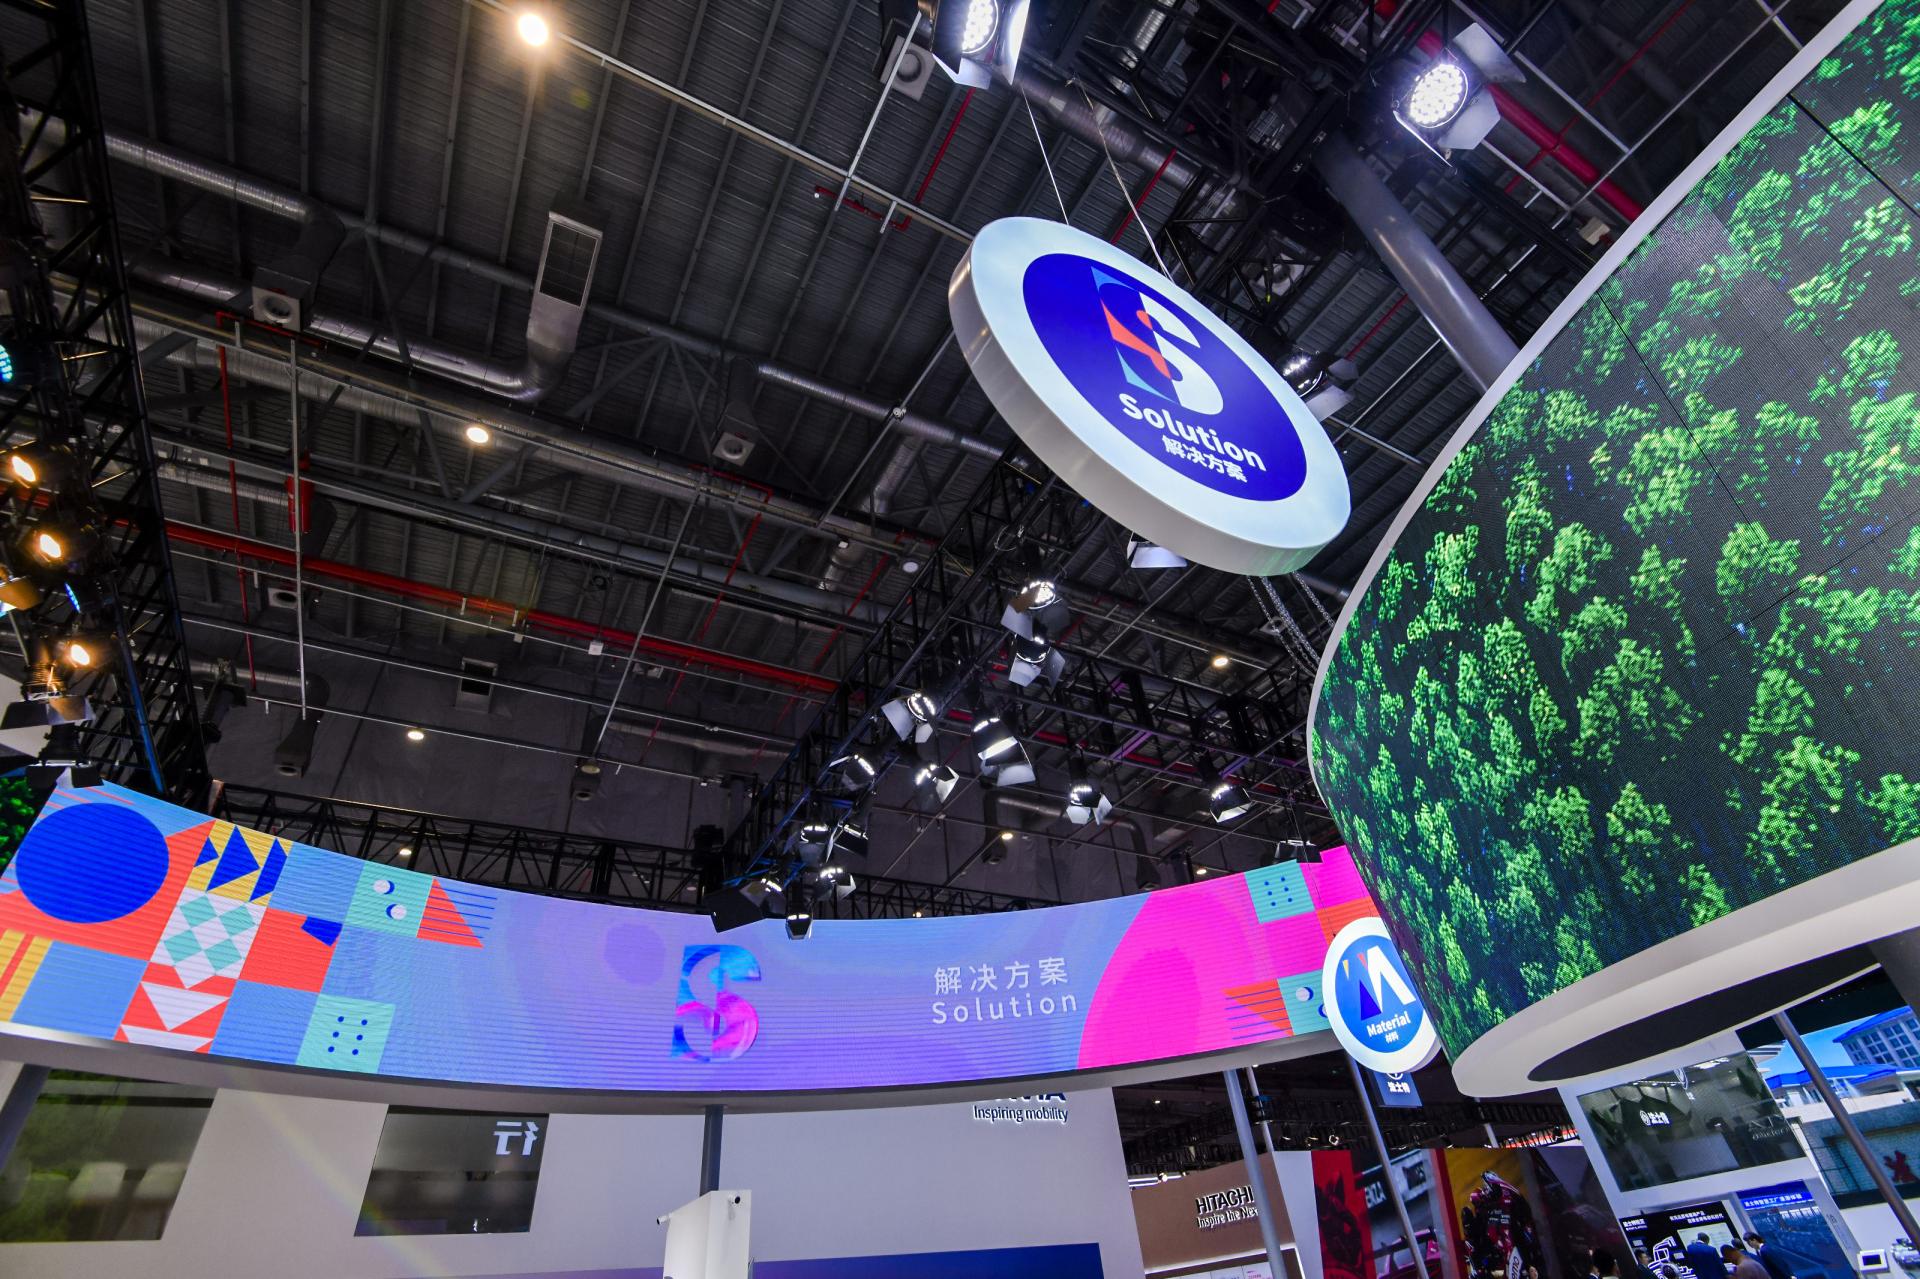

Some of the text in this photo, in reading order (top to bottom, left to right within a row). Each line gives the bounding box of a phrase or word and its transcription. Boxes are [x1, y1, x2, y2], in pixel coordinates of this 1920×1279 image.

[1119, 393, 1267, 472] Solution
[1162, 434, 1248, 483] 解决方案
[934, 957, 1068, 996] 解决方案
[931, 992, 1078, 1024] Solution
[1366, 1011, 1411, 1037] Material
[973, 1104, 1068, 1124] Inspiring mobility
[1195, 1185, 1255, 1215] HITACHI
[1197, 1213, 1226, 1229] Inspire
[1226, 1209, 1241, 1222] the
